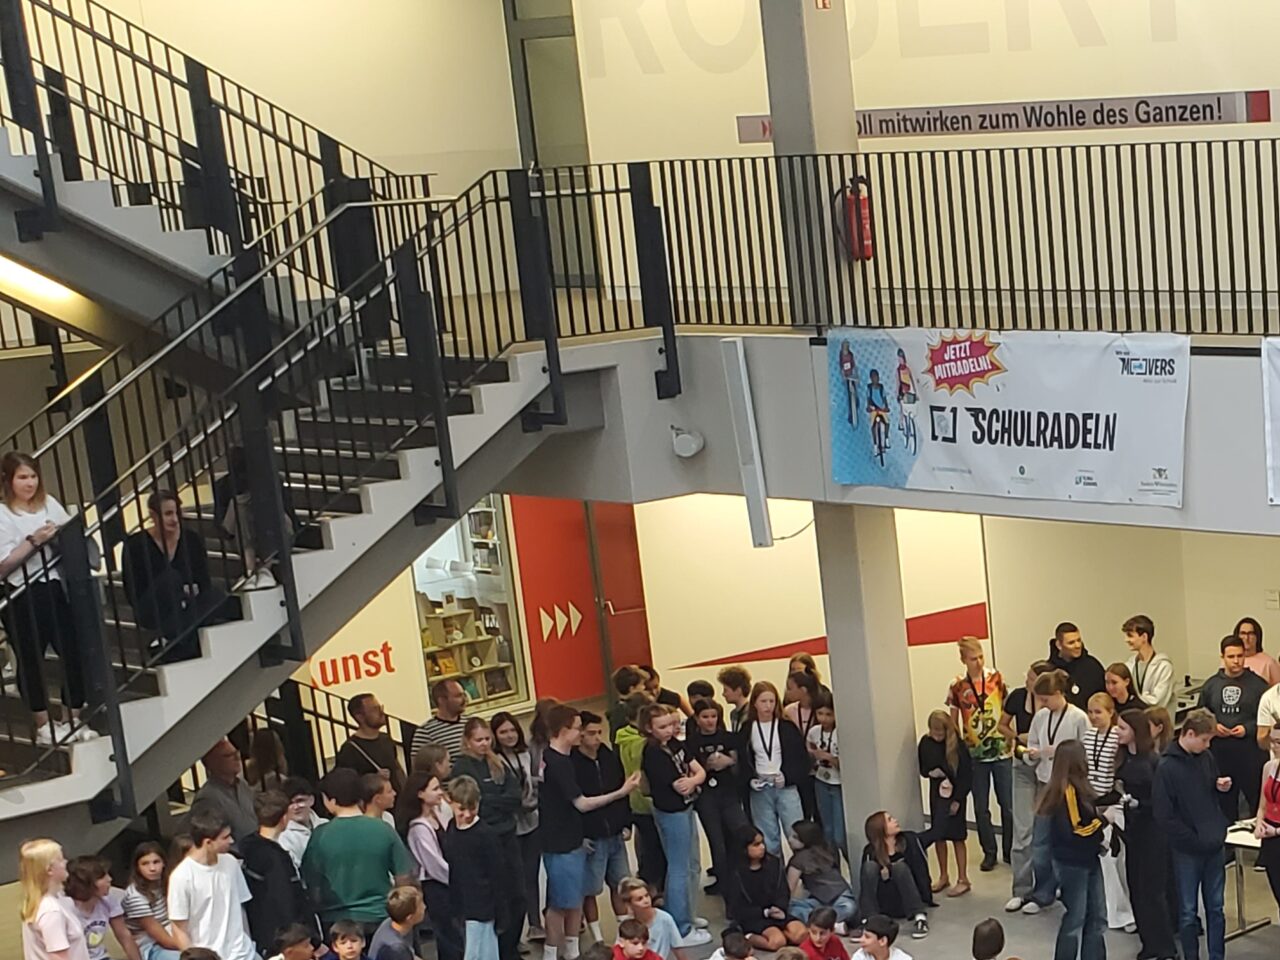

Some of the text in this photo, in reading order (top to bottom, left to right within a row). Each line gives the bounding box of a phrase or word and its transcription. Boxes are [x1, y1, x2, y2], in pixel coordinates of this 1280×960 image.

[879, 110, 972, 135] mitwirken
[978, 112, 1020, 131] zum
[1022, 102, 1087, 128] Wohle
[1093, 102, 1129, 126] des
[1134, 97, 1222, 124] Ganzen!
[934, 355, 992, 380] MITRADELN!
[944, 341, 971, 361] JETZT
[965, 406, 1117, 451] SCHULRADELN
[309, 641, 396, 688] unst
